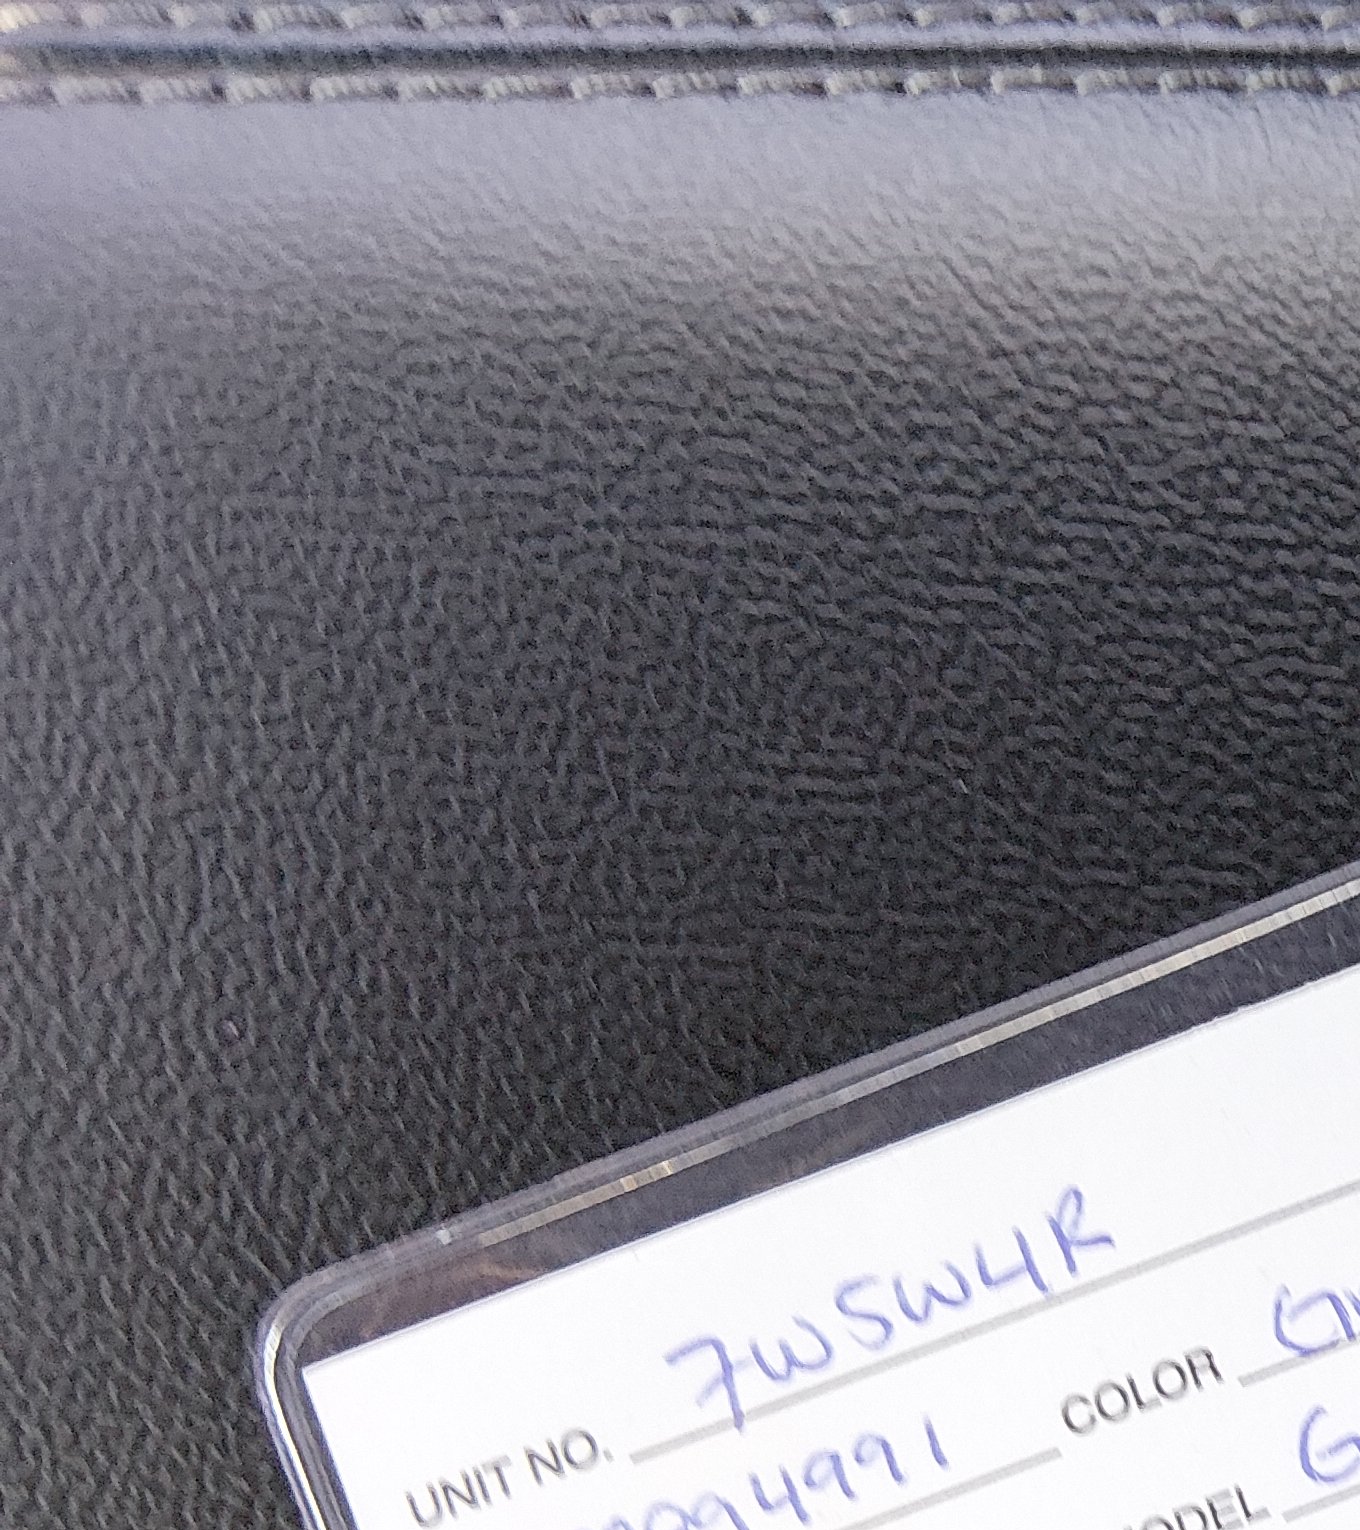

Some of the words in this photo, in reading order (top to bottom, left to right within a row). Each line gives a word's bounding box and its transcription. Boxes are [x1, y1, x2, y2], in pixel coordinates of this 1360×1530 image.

[1060, 1345, 1225, 1437] COLOR
[404, 1453, 514, 1529] UNIT
[522, 1426, 616, 1487] NO.
